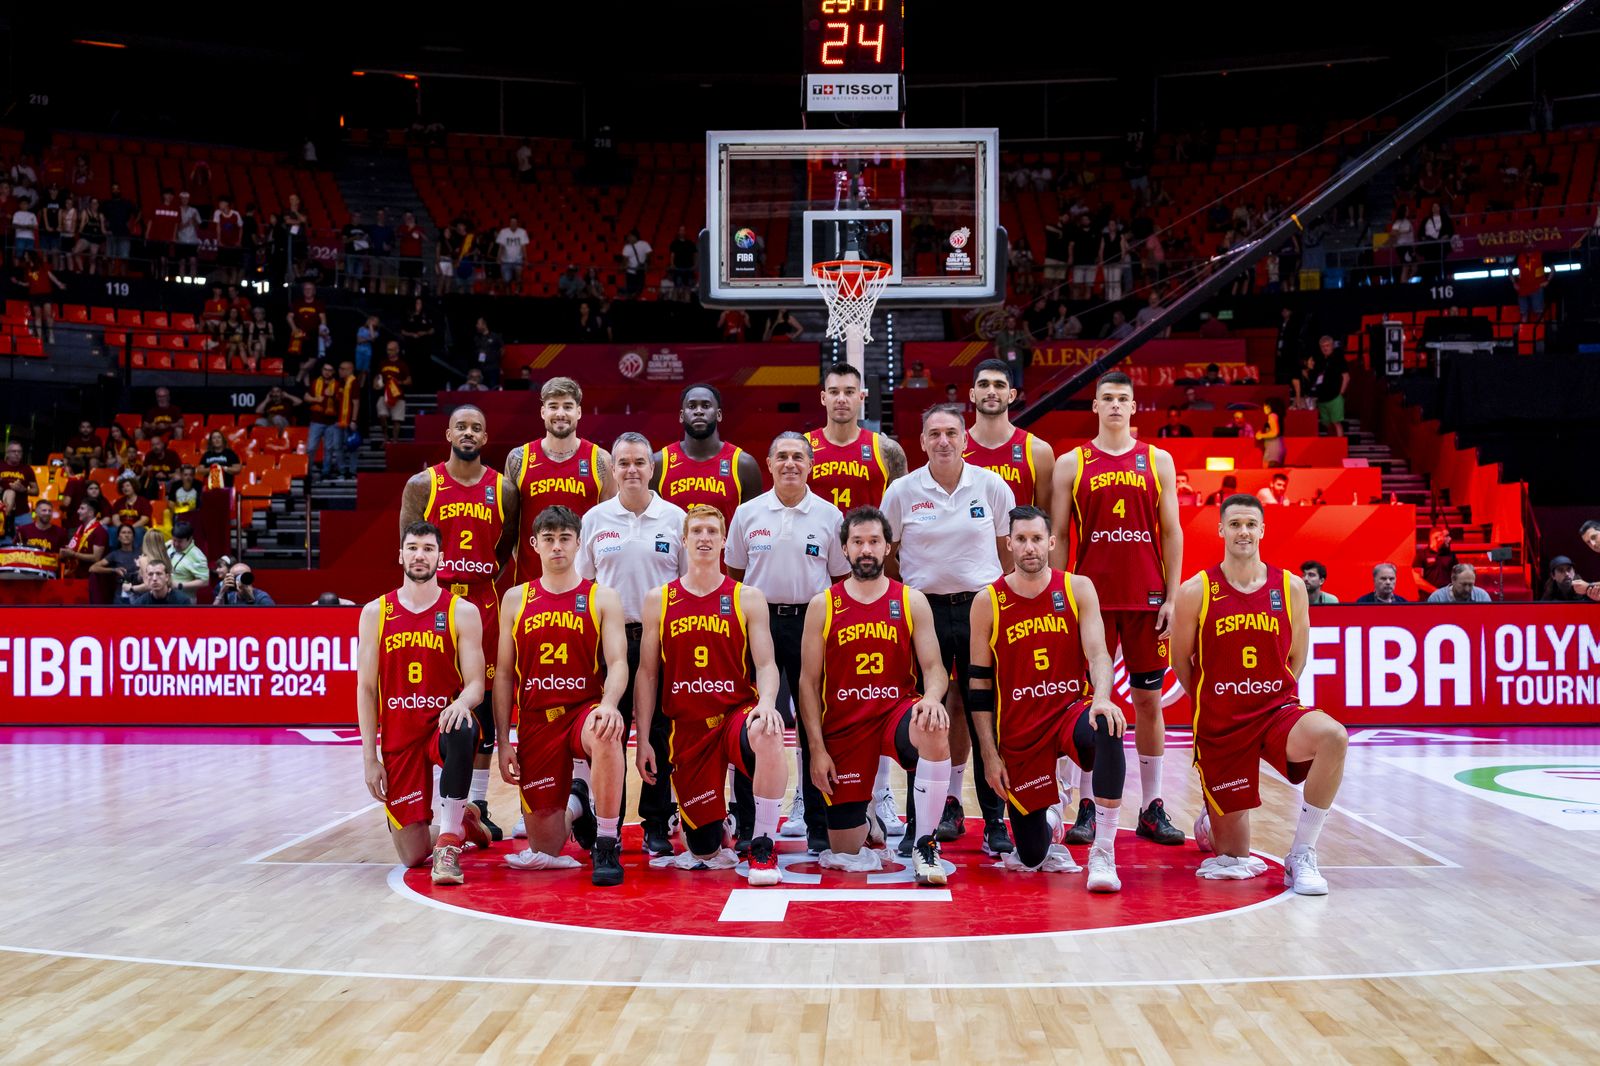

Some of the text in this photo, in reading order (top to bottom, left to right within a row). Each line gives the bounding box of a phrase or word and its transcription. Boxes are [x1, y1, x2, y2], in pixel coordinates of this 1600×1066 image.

[822, 22, 884, 65] 24
[836, 84, 893, 95] TISSOT
[736, 253, 754, 262] FIBA
[106, 282, 129, 296] 119
[1430, 285, 1454, 300] 116
[230, 393, 255, 407] 100
[812, 460, 869, 480] ESPAÑA
[530, 476, 586, 497] ESPAÑA
[670, 477, 726, 497] ESPAÑA
[1090, 470, 1146, 492] ESPAÑA
[831, 488, 850, 508] 14
[912, 501, 934, 512] ESPAÑA
[439, 502, 492, 524] ESPAÑA
[1112, 499, 1126, 518] 4
[460, 530, 472, 550] 2
[597, 531, 620, 542] ESPAÑA
[750, 528, 770, 539] ESPAÑA
[1090, 527, 1151, 543] endesa
[437, 558, 493, 574] endesa
[524, 611, 583, 634] ESPAÑA
[670, 614, 730, 638] ESPAÑA
[1006, 614, 1068, 644] ESPAÑA
[1216, 612, 1279, 636] ESPAÑA
[385, 630, 444, 653] ESPAÑA
[838, 621, 897, 646] ESPAÑA
[120, 636, 259, 671] OLYMPIC
[540, 643, 568, 665] 24
[694, 646, 708, 667] 9
[856, 652, 884, 674] 23
[1033, 648, 1050, 670] 5
[1242, 646, 1257, 668] 6
[408, 662, 422, 683] 8
[1298, 624, 1472, 706] FIBA
[120, 674, 326, 696] TOURNAMENT 2024
[525, 674, 586, 691] endesa
[672, 677, 734, 694] endesa
[837, 684, 899, 700] endesa
[1013, 680, 1080, 700] endesa
[1215, 678, 1282, 695] endesa
[1496, 676, 1600, 705] TOURN
[388, 693, 447, 710] endesa
[523, 776, 554, 790] azulmarino
[1015, 775, 1050, 792] azulmarino
[1212, 778, 1248, 792] azulmarino
[391, 790, 421, 806] azulmarino
